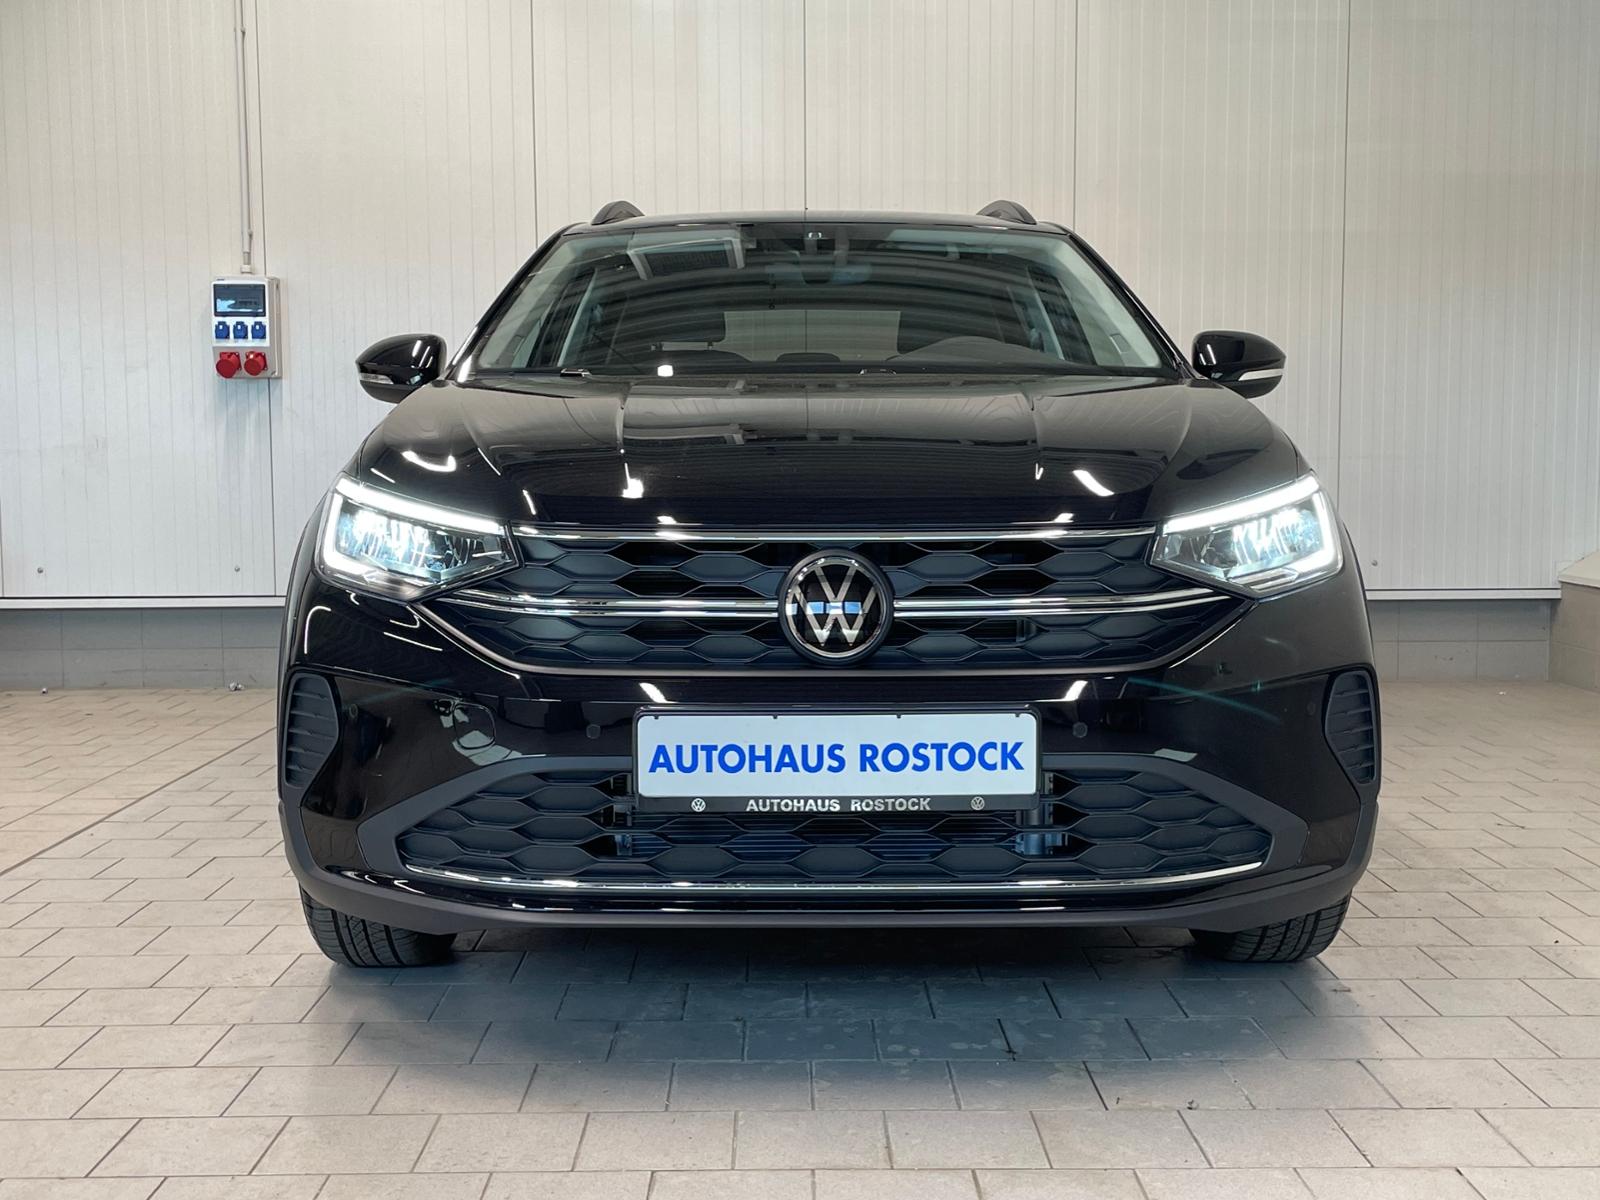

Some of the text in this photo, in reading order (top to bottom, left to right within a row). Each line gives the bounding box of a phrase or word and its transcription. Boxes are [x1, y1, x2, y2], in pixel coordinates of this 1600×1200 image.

[648, 741, 1024, 774] AUTOHAUS ROSTOCK
[746, 798, 931, 812] AUTOHAUS ROSTOCK
